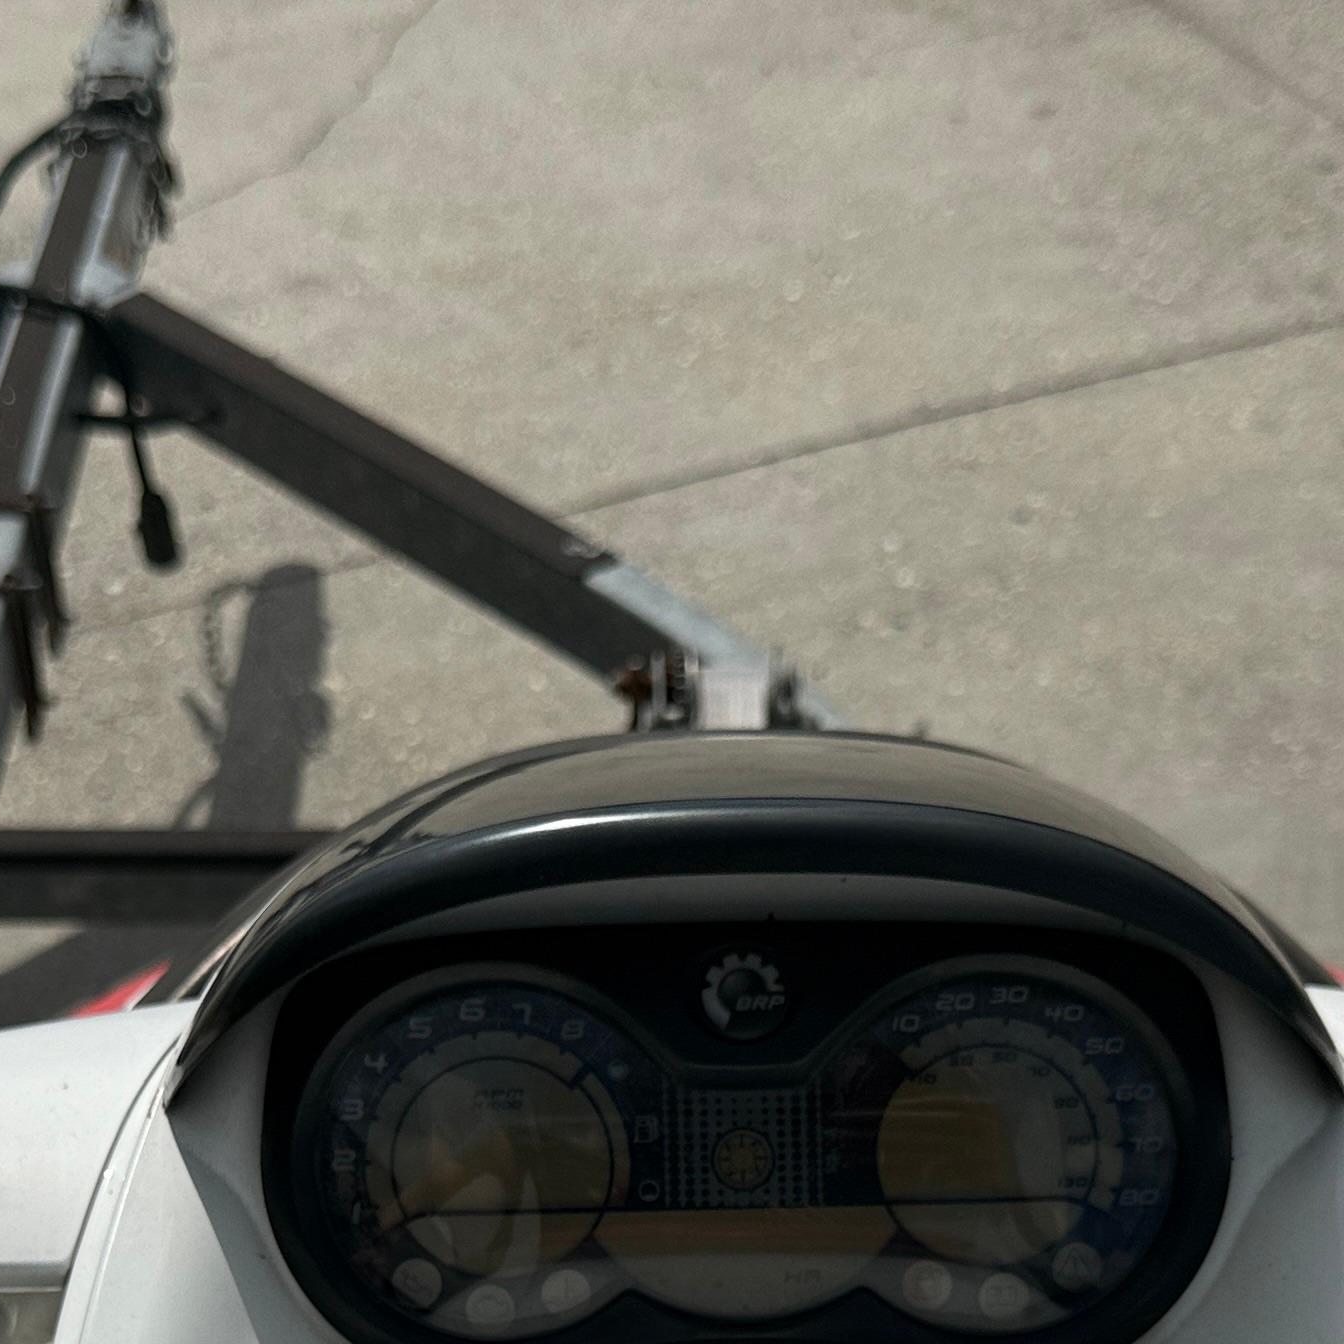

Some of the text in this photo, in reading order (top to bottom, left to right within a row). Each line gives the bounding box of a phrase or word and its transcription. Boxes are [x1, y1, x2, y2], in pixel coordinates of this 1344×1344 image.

[735, 994, 785, 1013] BRP
[935, 991, 977, 1012] 20
[989, 985, 1031, 1005] 30
[459, 996, 488, 1022] 6
[512, 1002, 533, 1025] 7
[1043, 1003, 1087, 1022] 40
[407, 1015, 433, 1040] 5
[560, 1018, 585, 1041] 8
[892, 1013, 922, 1034] 10
[1084, 1036, 1126, 1055] 50
[364, 1052, 389, 1075] 4
[1114, 1083, 1156, 1102] 60
[340, 1098, 365, 1121] 3
[1133, 1135, 1164, 1154] 70
[332, 1148, 356, 1172] 2
[1117, 1188, 1160, 1208] 80
[351, 1200, 363, 1225] 1
